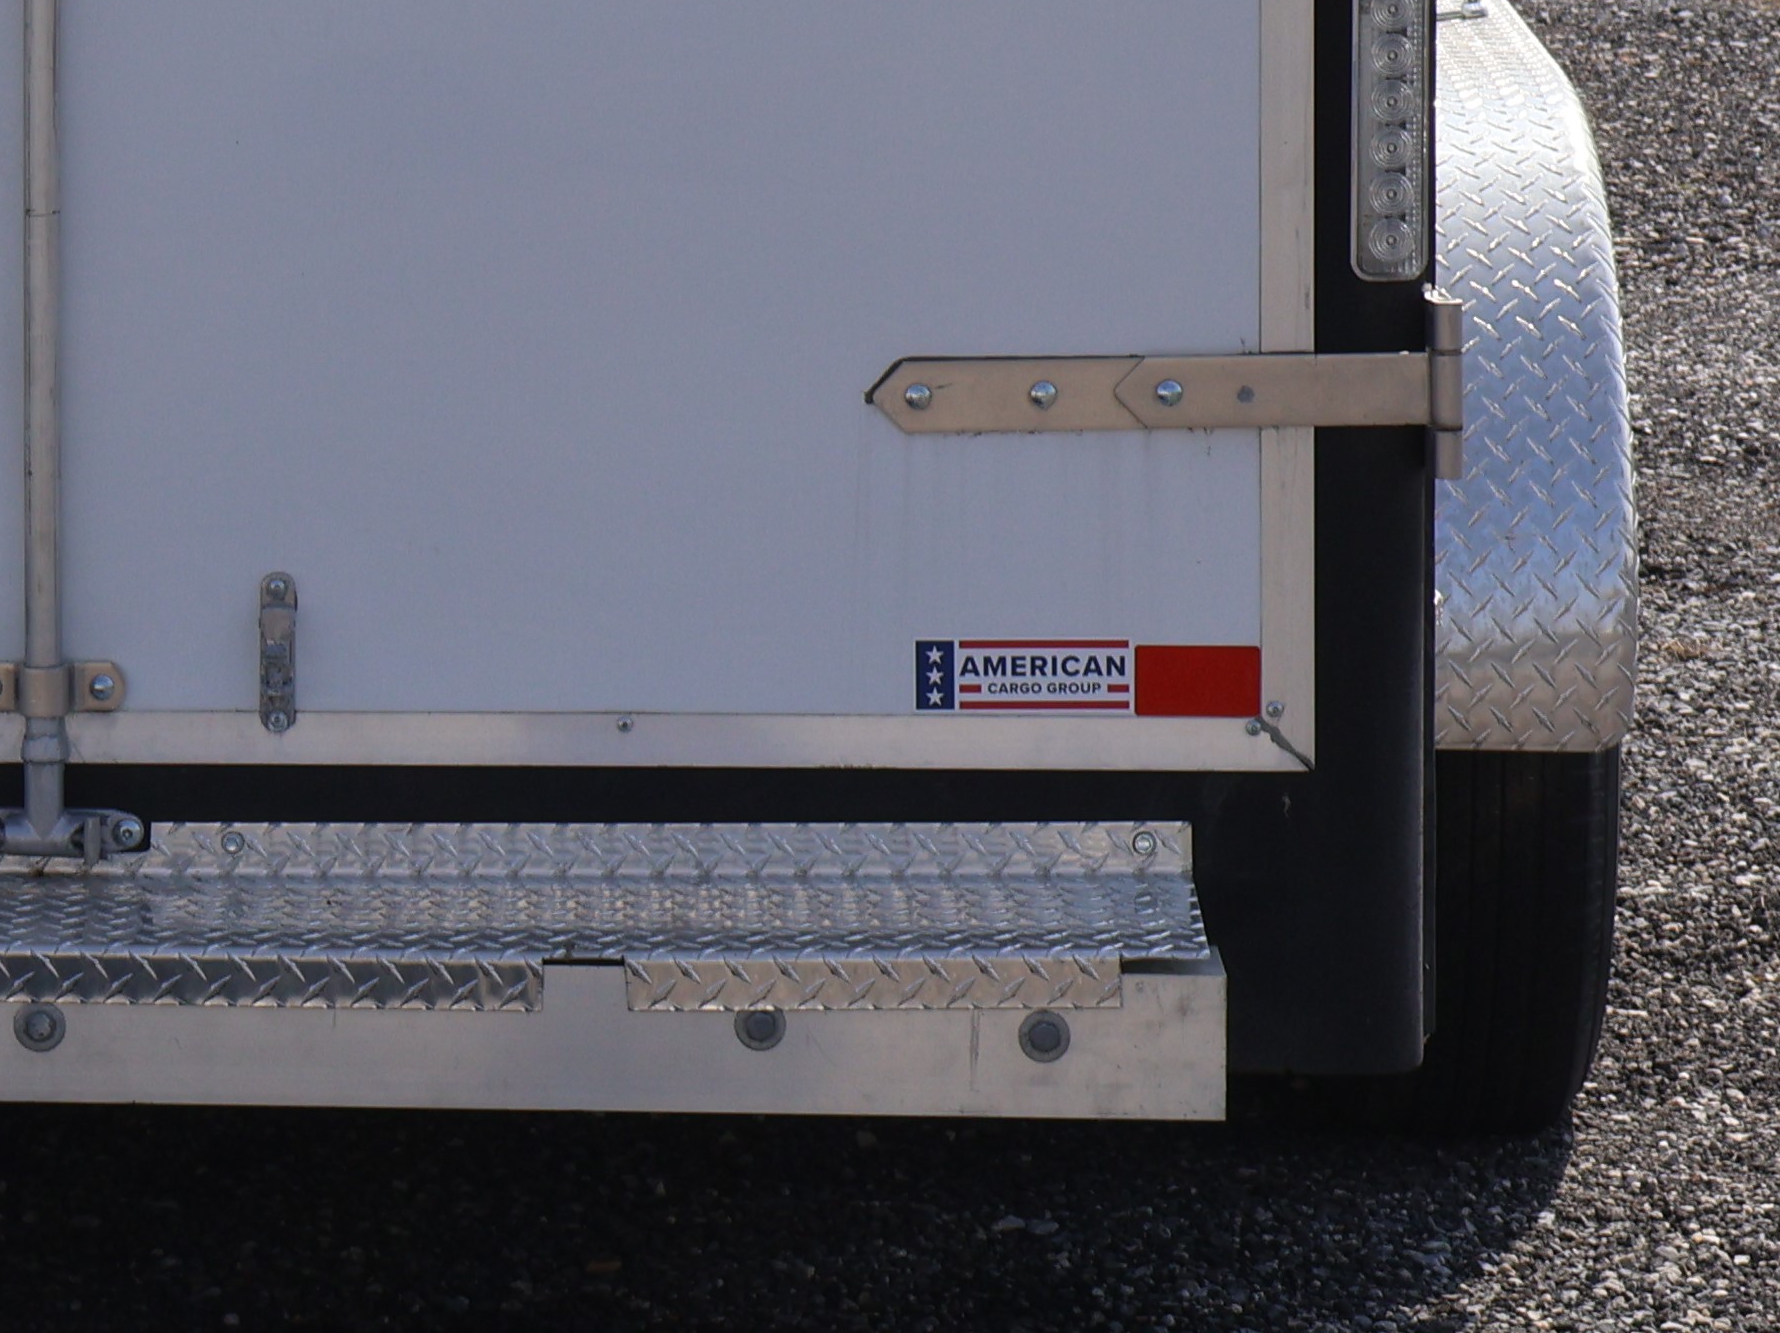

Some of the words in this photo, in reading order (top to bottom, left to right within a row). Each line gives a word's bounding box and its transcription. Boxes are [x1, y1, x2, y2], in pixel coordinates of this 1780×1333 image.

[958, 655, 1126, 677] AMERICAN
[987, 682, 1042, 695] CARGO
[1047, 682, 1102, 695] GROUP
